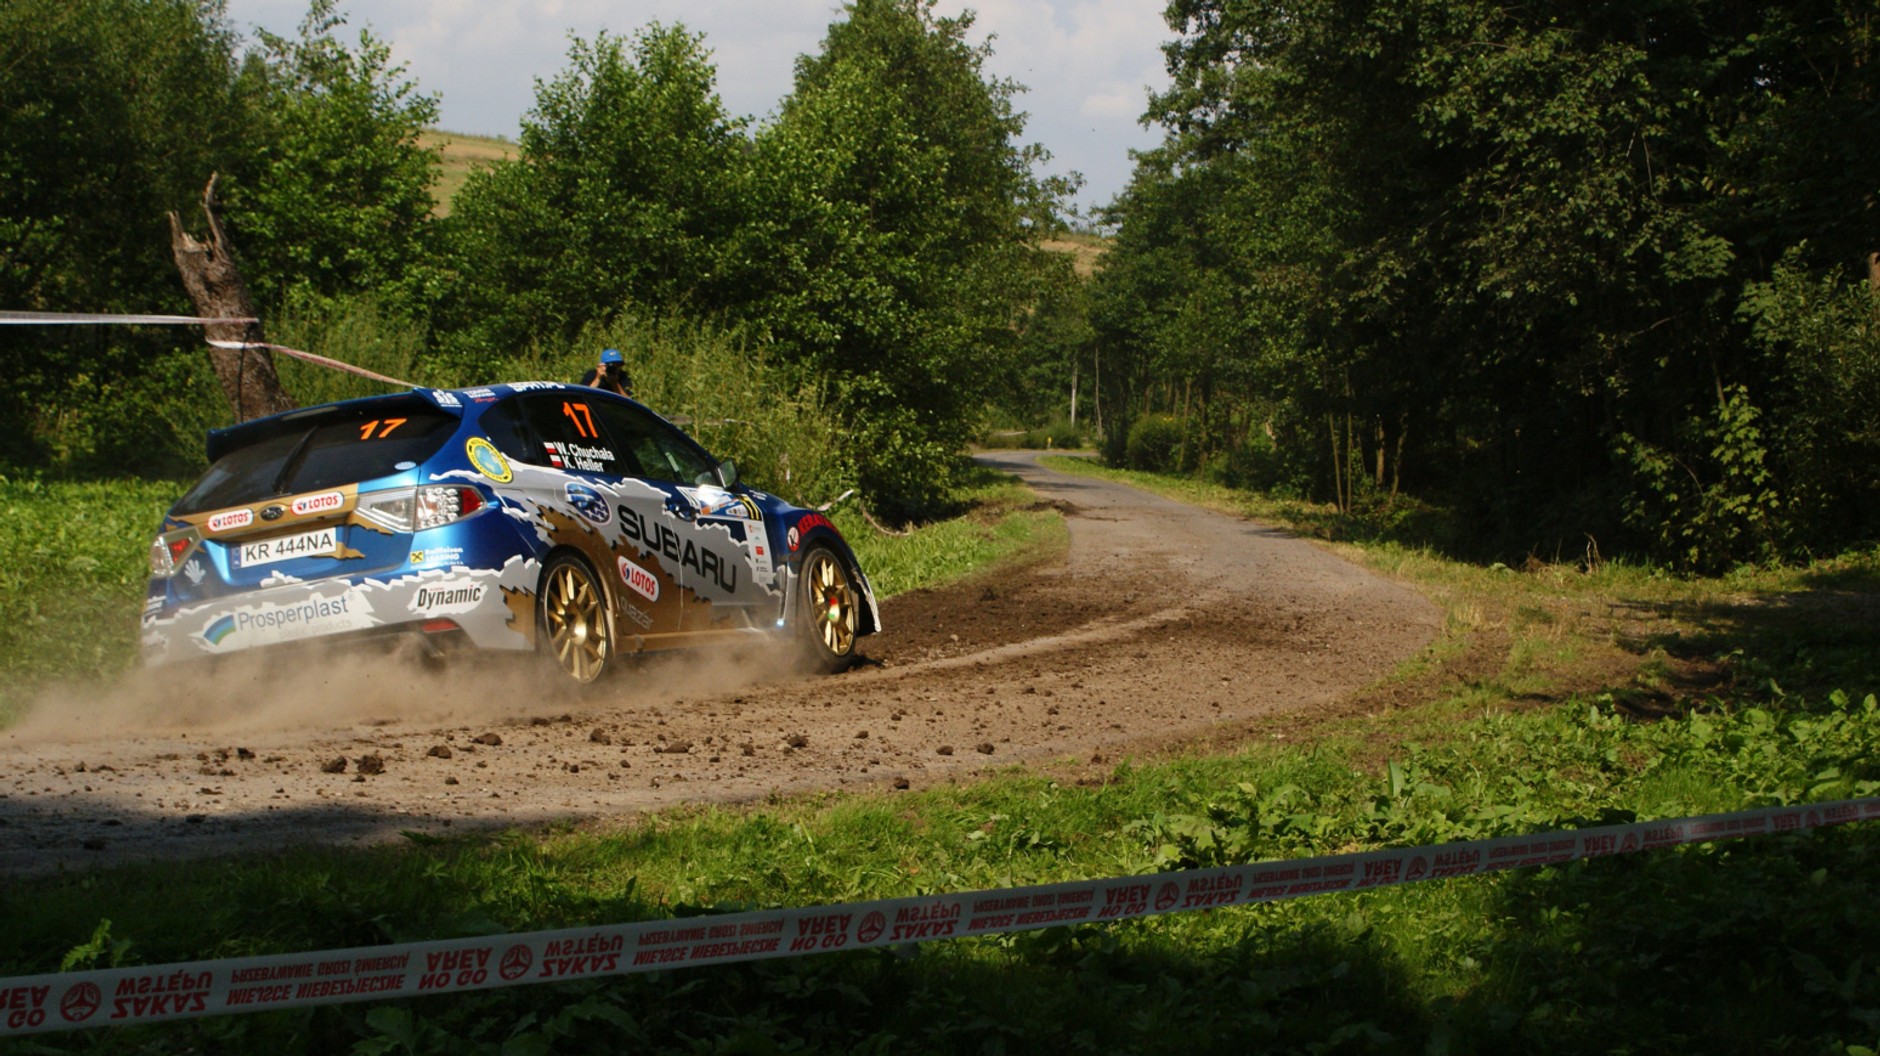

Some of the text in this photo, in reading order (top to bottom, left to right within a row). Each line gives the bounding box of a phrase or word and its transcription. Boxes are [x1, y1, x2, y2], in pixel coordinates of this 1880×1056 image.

[360, 418, 407, 440] 17
[563, 401, 598, 438] 17
[553, 441, 570, 456] W.
[561, 454, 604, 472] K. Heller
[308, 495, 338, 510] LOTOS
[222, 512, 249, 527] LOTOS
[245, 532, 333, 561] KR 444NA
[618, 504, 736, 593] SUBARU
[631, 568, 655, 596] LOTOS
[418, 585, 481, 610] Dynamic
[238, 596, 349, 631] Prosperplast
